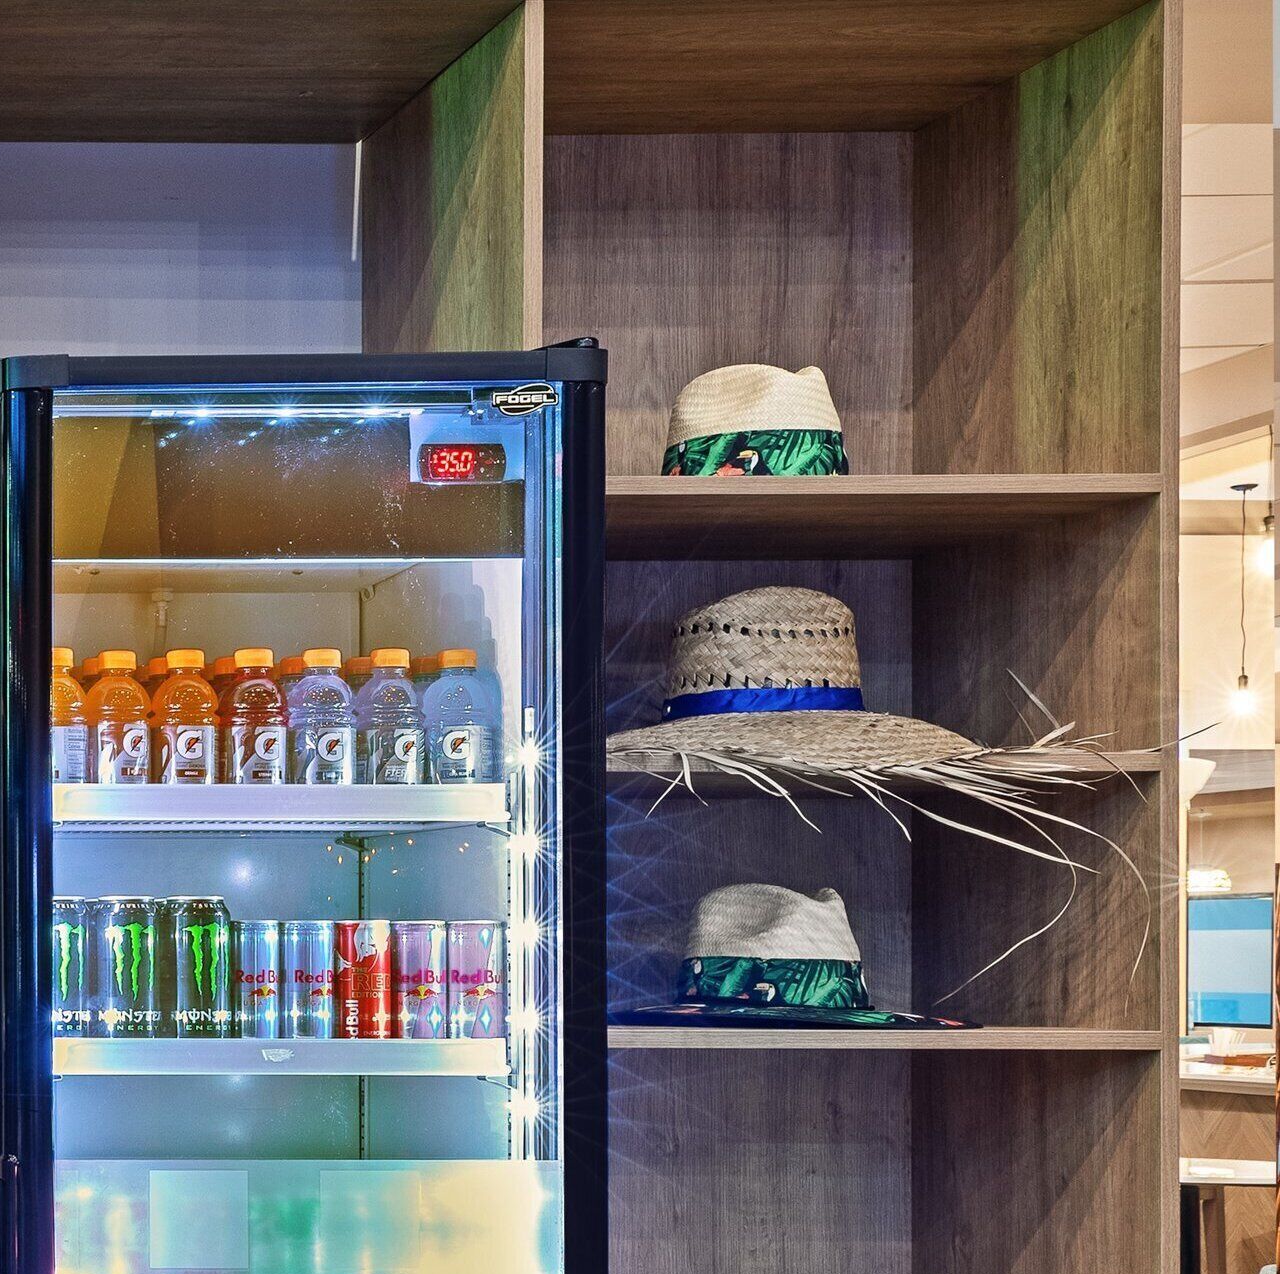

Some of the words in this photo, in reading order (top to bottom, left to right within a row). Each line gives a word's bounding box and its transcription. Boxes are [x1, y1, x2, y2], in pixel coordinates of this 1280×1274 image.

[496, 394, 555, 404] FOGEL
[236, 969, 265, 985] Red
[294, 969, 323, 984] Red
[451, 970, 481, 985] Red
